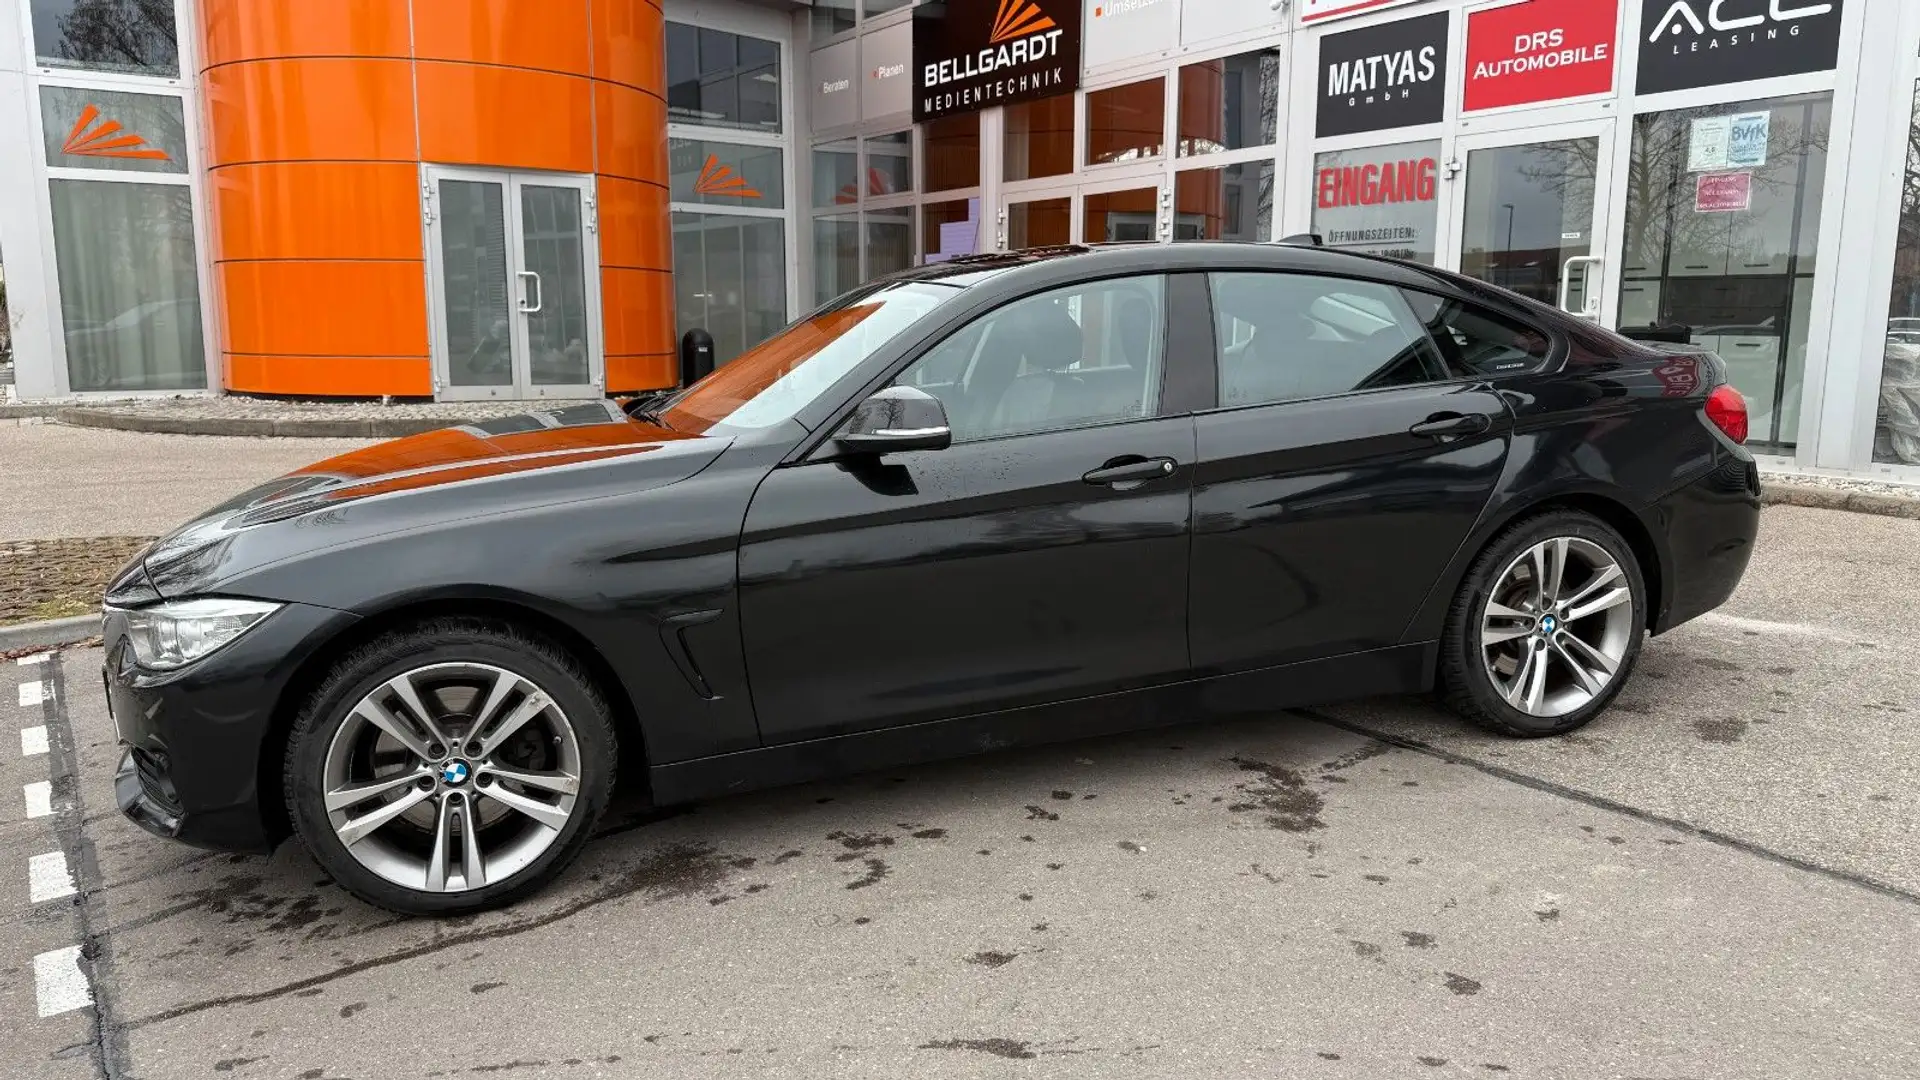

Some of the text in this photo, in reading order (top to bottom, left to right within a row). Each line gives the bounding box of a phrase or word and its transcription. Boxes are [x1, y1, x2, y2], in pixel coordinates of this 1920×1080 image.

[1104, 0, 1163, 17] Umsetz
[1514, 28, 1564, 54] DRS
[1673, 25, 1799, 55] LEASING
[878, 64, 904, 80] Planen
[925, 29, 1063, 88] BELLGARDT
[1328, 45, 1436, 96] MATYAS
[1473, 43, 1608, 80] AUTOMOBILE
[924, 67, 1062, 113] MEDIENTECHNIK
[1349, 88, 1409, 106] GmbH
[1318, 157, 1436, 208] EINGANG
[1328, 226, 1415, 242] ÖFFNUNGSZEITEN:
